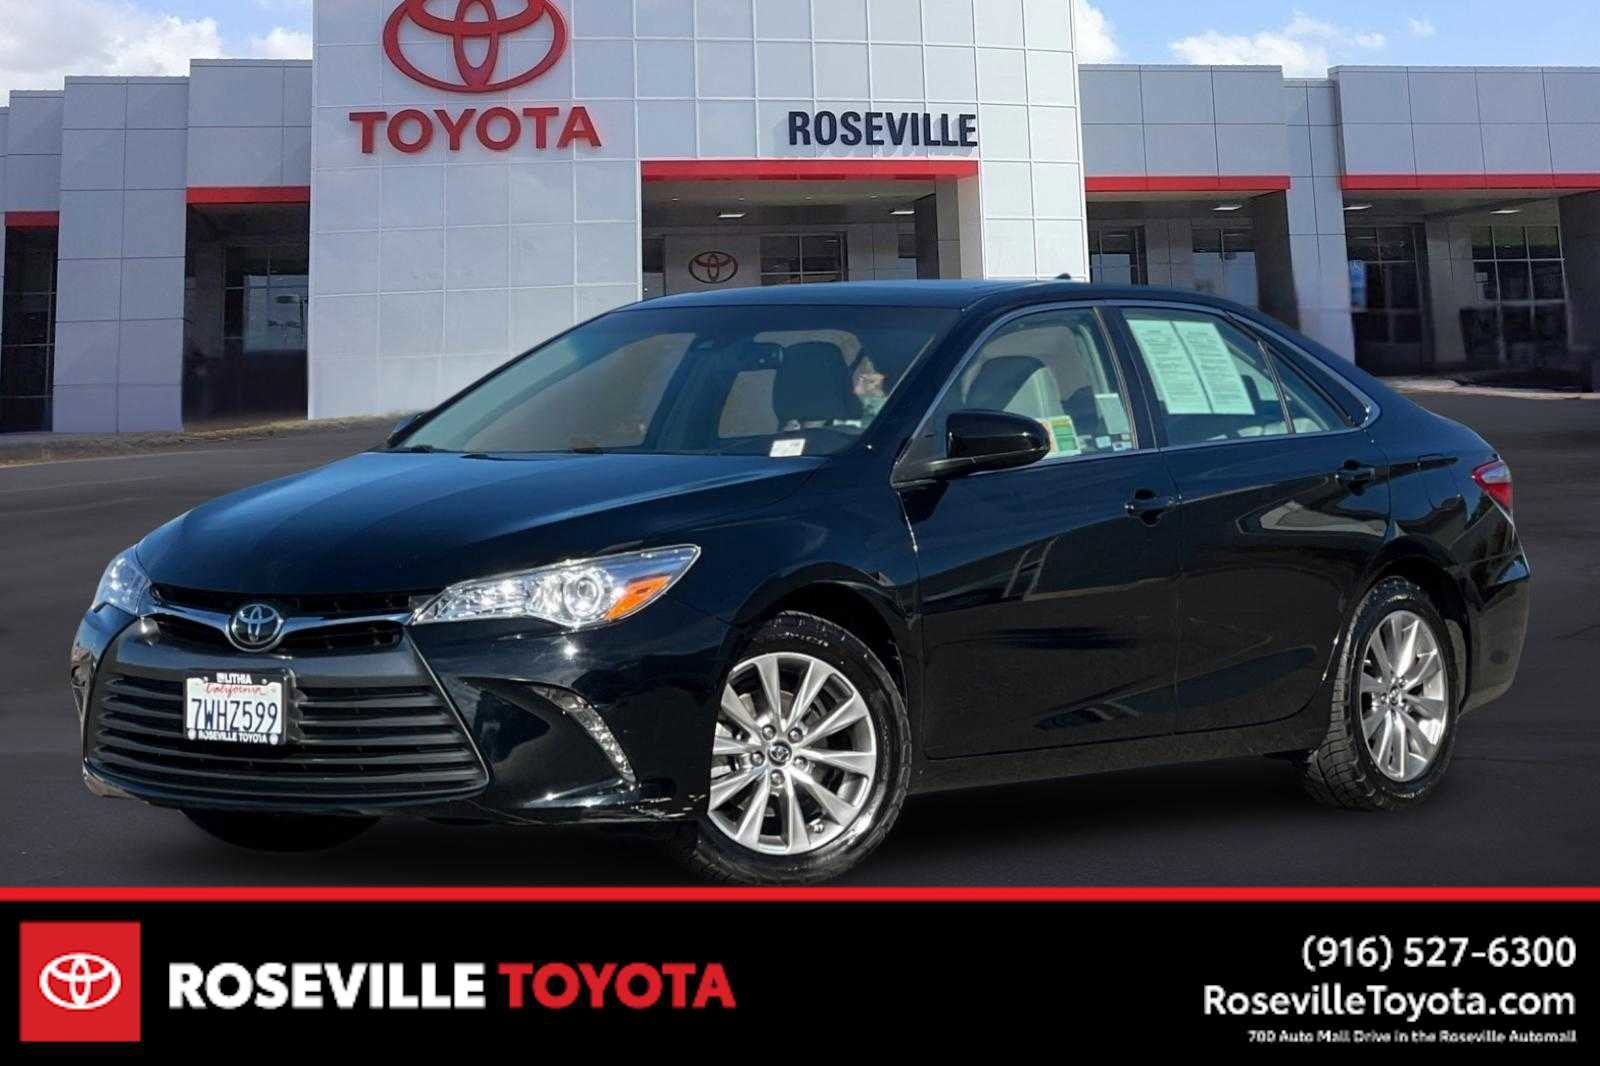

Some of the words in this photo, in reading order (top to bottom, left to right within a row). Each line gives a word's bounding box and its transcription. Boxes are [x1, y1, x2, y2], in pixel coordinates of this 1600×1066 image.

[349, 106, 602, 154] TOYOTA
[788, 110, 978, 147] ROSEVILLE
[191, 698, 278, 732] 7WHZ599
[198, 730, 238, 742] ROSEVILLE
[239, 732, 268, 744] TOYOTA
